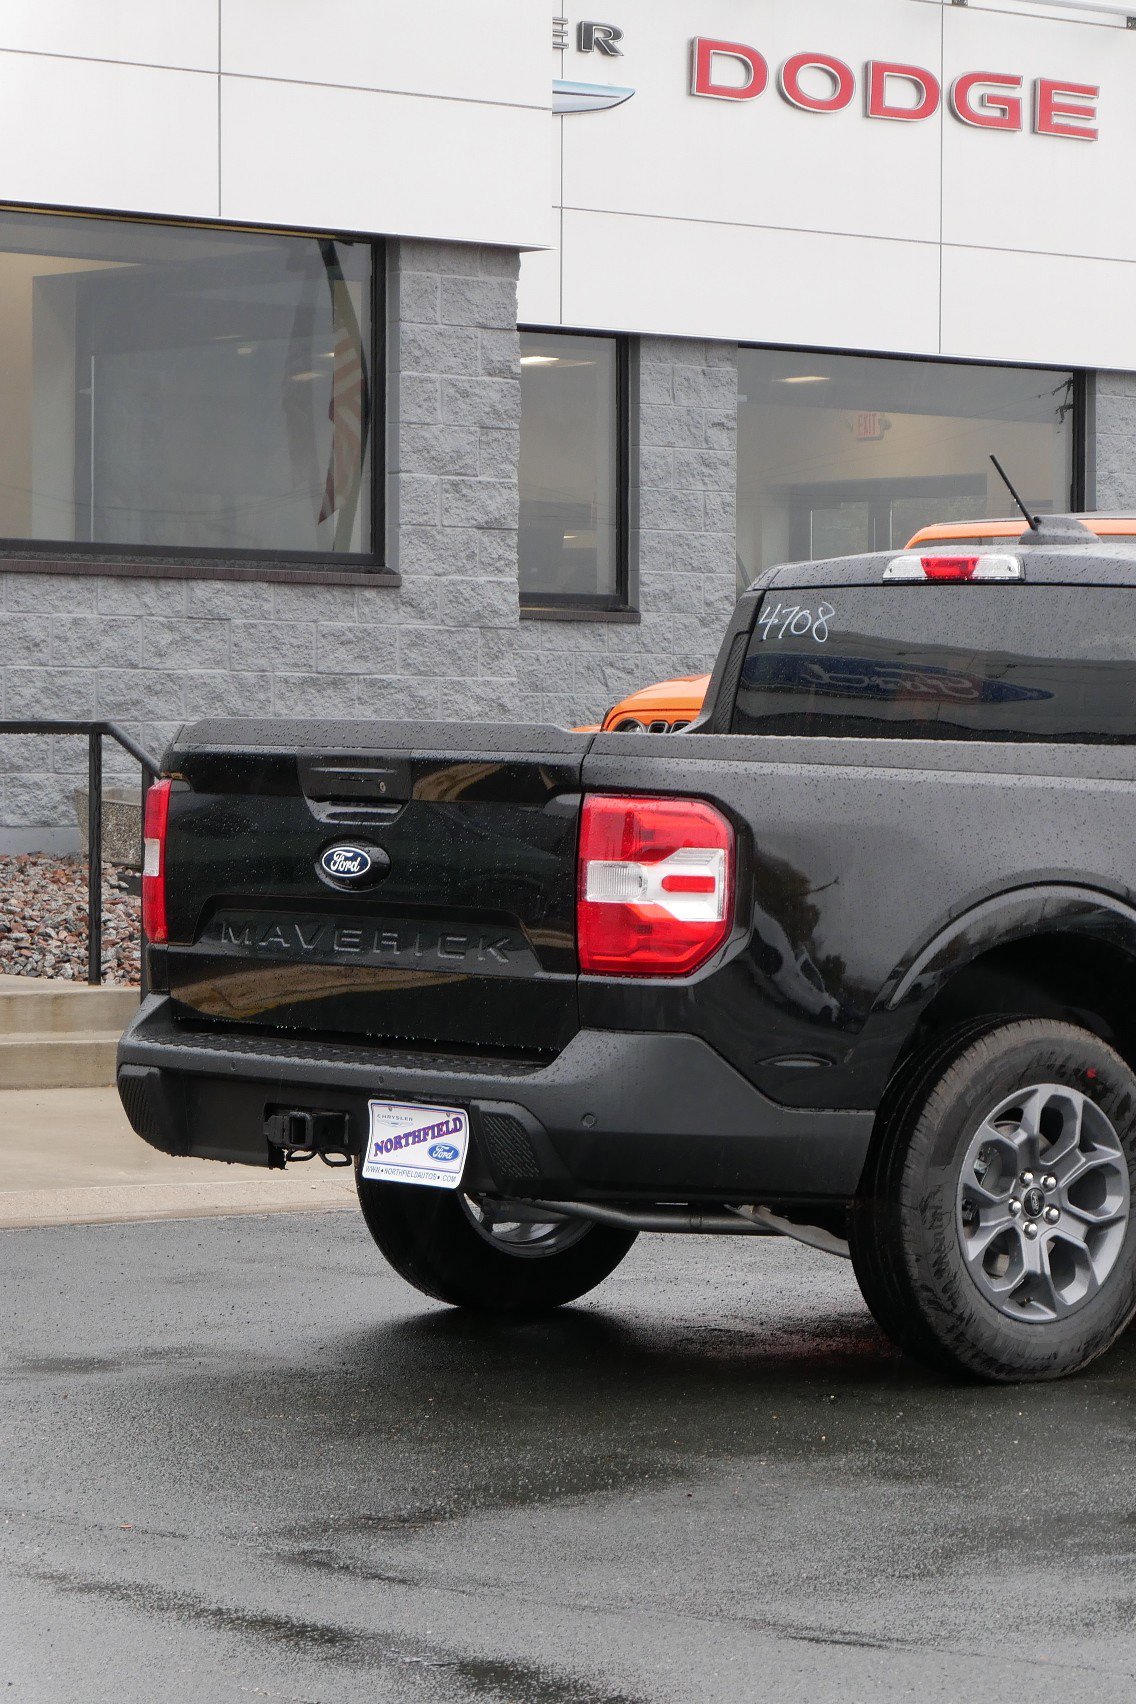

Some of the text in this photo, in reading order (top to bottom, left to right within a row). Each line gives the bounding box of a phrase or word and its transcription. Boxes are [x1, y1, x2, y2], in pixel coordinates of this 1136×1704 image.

[690, 36, 1099, 141] DODGE
[857, 412, 878, 435] EXIT
[758, 601, 836, 643] 4708
[330, 850, 362, 873] Ford
[219, 922, 510, 964] MAVERICK
[377, 1113, 413, 1122] CHRYSLER
[374, 1116, 463, 1157] NORTHFIELD
[432, 1143, 455, 1160] Ford
